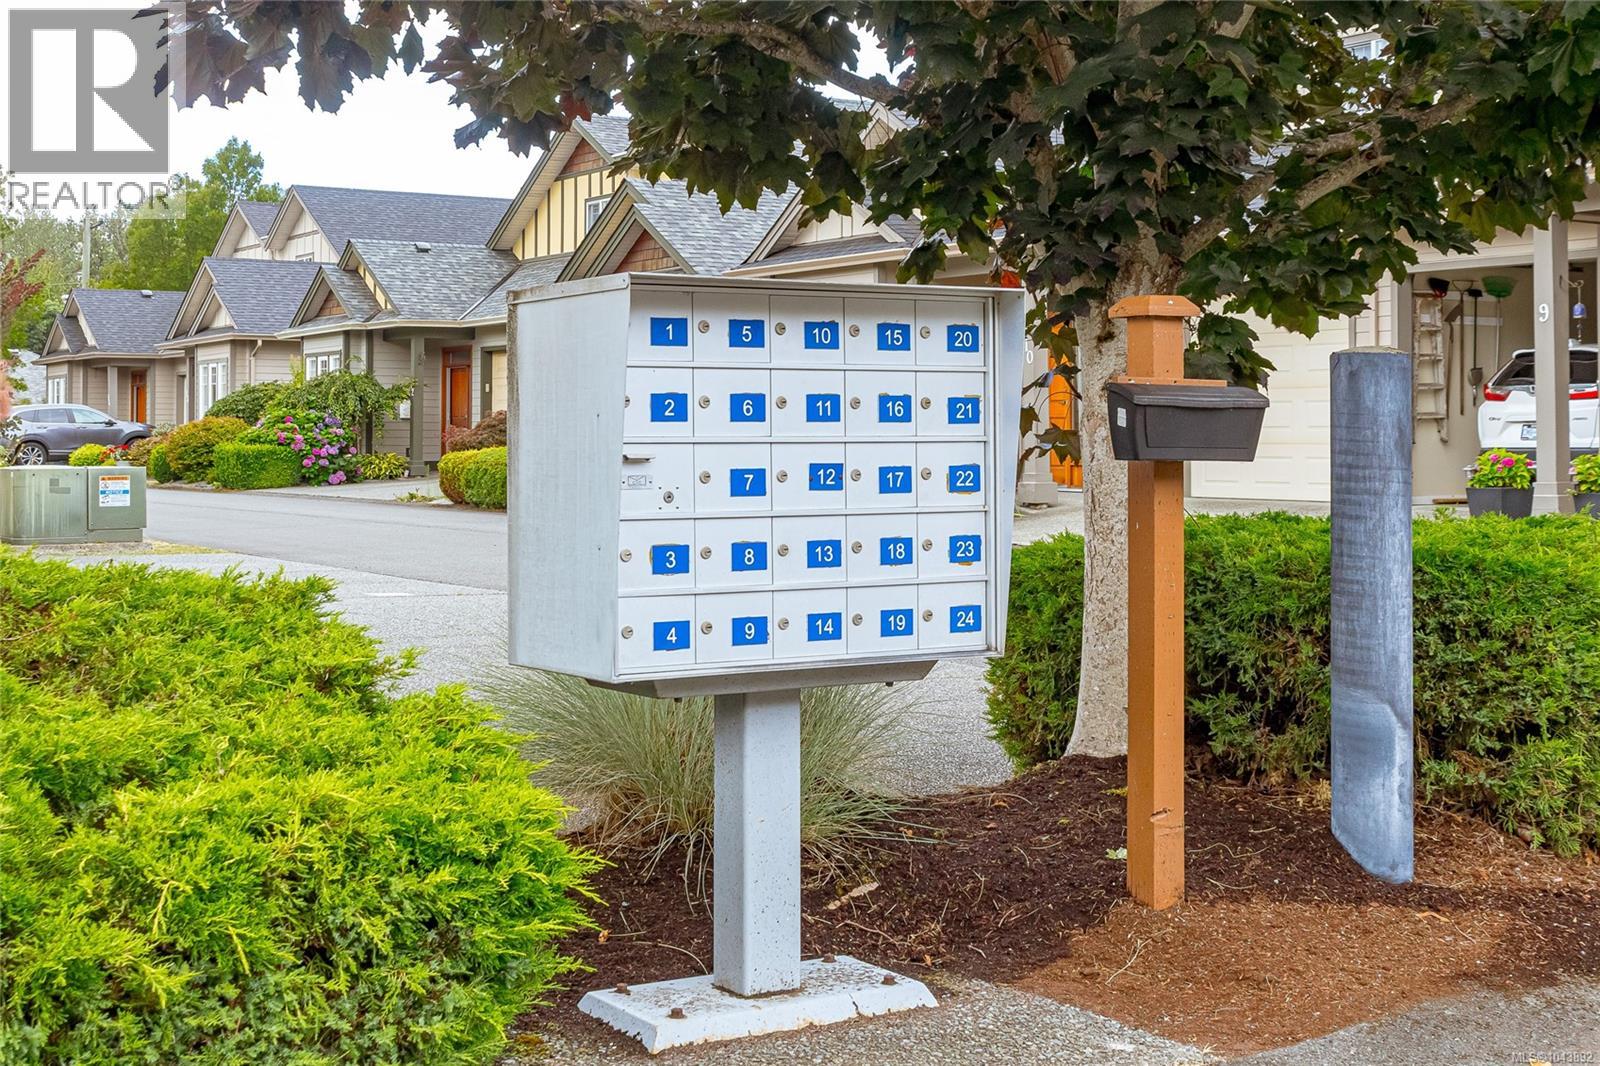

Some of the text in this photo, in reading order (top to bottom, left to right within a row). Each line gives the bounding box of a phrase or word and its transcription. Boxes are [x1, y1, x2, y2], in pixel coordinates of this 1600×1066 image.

[1538, 303, 1549, 322] 9
[665, 323, 673, 340] 1
[742, 325, 752, 343] 5
[812, 327, 831, 344] 10
[885, 329, 903, 346] 15
[954, 331, 972, 348] 20
[664, 398, 675, 417] 2
[742, 399, 753, 417] 6
[816, 400, 831, 417] 11
[886, 400, 904, 417] 16
[955, 402, 972, 419] 21
[743, 474, 754, 491] 7
[817, 468, 836, 485] 12
[886, 471, 904, 488] 17
[955, 470, 974, 487] 22
[744, 548, 755, 566] 8
[815, 545, 834, 562] 13
[887, 542, 906, 560] 18
[956, 540, 975, 558] 23
[665, 550, 677, 569] 3
[815, 618, 834, 635] 14
[888, 614, 906, 631] 19
[956, 610, 975, 628] 24
[666, 626, 678, 644] 4
[744, 622, 755, 640] 9
